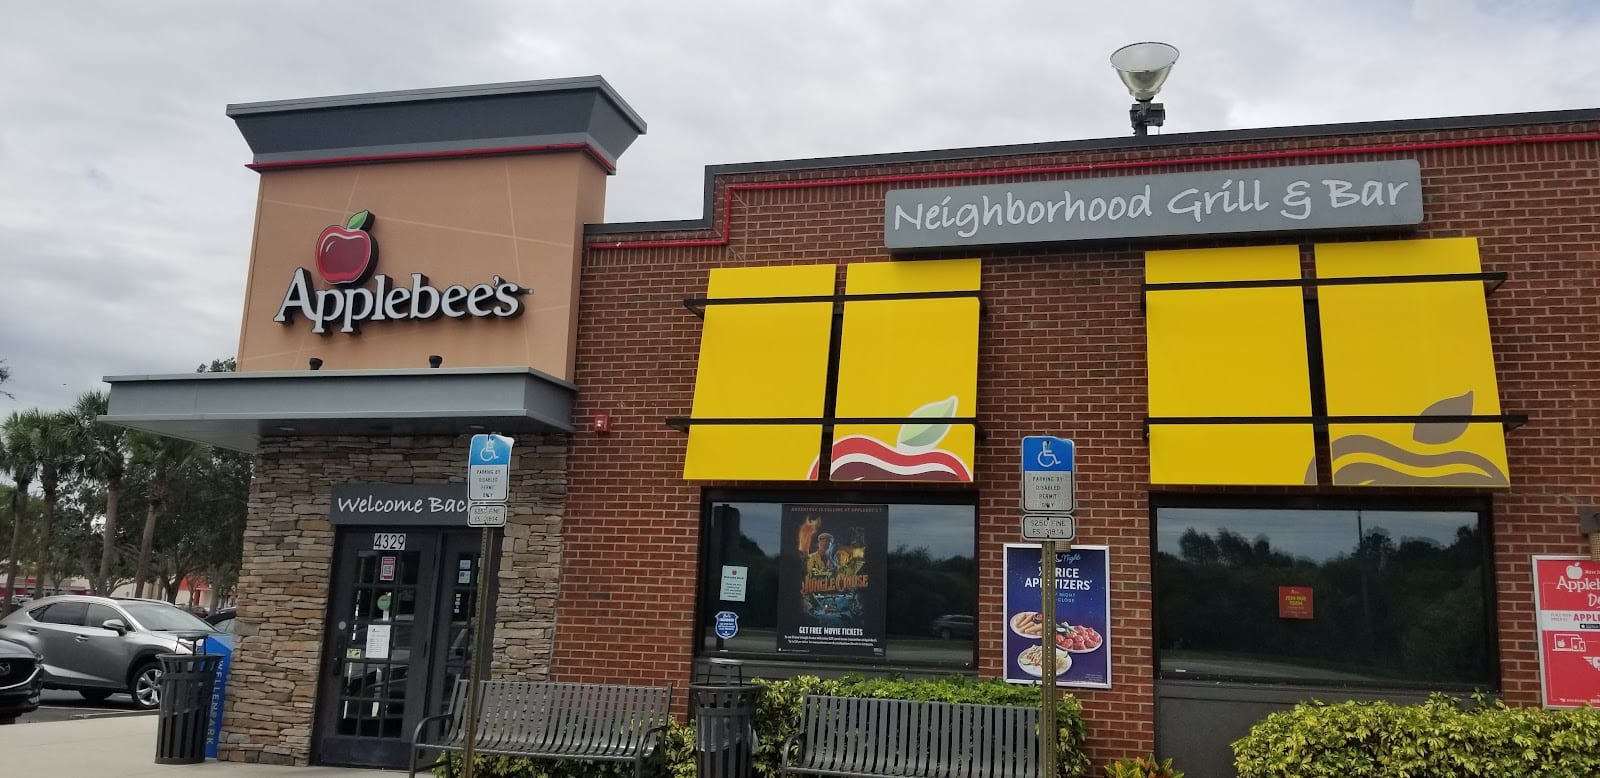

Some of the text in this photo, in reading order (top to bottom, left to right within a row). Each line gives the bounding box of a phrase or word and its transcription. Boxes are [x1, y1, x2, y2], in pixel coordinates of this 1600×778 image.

[894, 179, 1409, 238] Neighborhood Grill & Bar
[272, 267, 520, 333] Applebee's
[338, 495, 468, 513] Welcome Bac
[1031, 519, 1066, 527] $250 FINE
[374, 534, 405, 550] 4329
[1055, 567, 1080, 578] RICE
[799, 626, 863, 636] GET FREE MOVIE TICKETS
